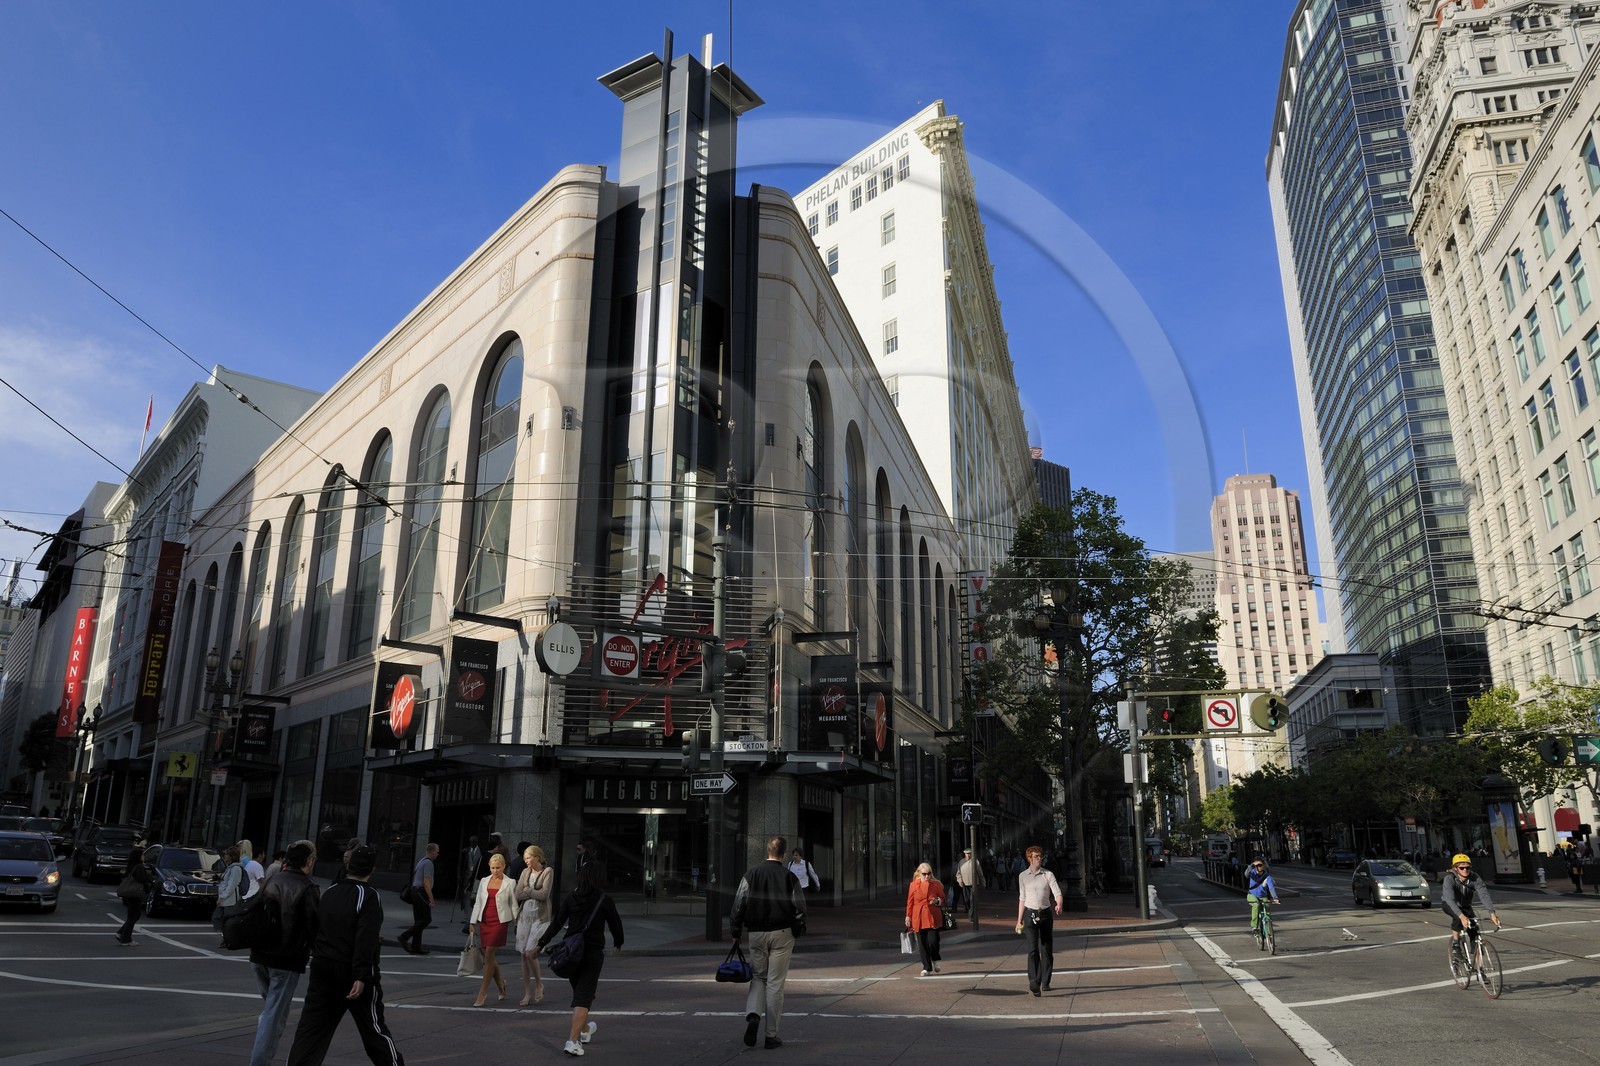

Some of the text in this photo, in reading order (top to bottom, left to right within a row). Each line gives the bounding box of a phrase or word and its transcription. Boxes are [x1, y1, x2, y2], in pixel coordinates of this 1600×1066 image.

[806, 132, 909, 211] PHELAN BUILDING
[159, 568, 175, 627] STORE
[549, 643, 575, 655] ELLIS
[608, 643, 634, 652] DO NOT
[142, 633, 166, 698] Ferrari
[467, 662, 489, 670] FRANCISCO
[610, 659, 631, 668] ENTER
[61, 618, 86, 727] BARNEYS
[460, 673, 485, 698] Virgin
[391, 676, 415, 735] Virgin
[455, 702, 485, 711] MEGASTORE
[822, 688, 845, 710] Virgin
[729, 742, 765, 750] STOCKTON
[695, 779, 723, 788] ONE WAY
